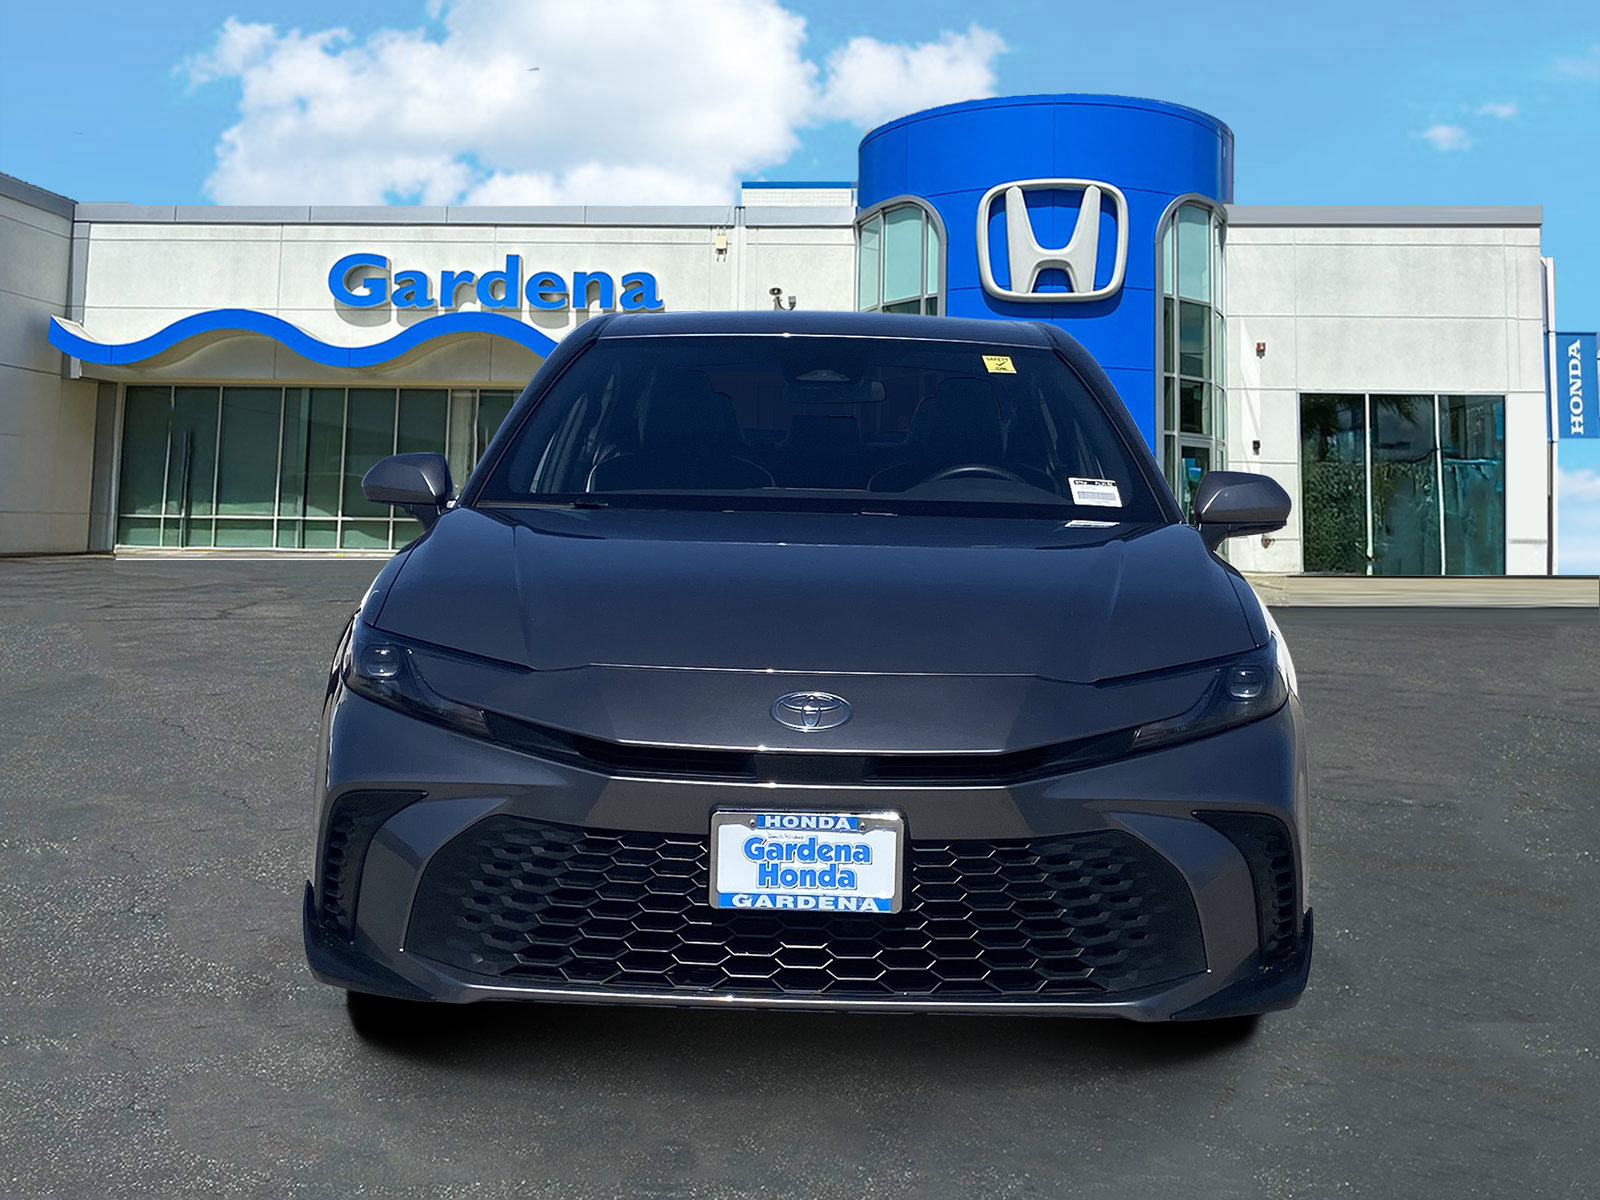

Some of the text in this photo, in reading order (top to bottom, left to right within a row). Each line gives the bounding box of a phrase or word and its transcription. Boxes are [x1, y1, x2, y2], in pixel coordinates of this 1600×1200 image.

[328, 252, 665, 309] Gardena
[1568, 339, 1584, 435] HONDA
[764, 815, 851, 830] HONDA
[743, 835, 872, 865] Gardena
[757, 862, 858, 889] Honda
[731, 894, 879, 911] GARDENA
